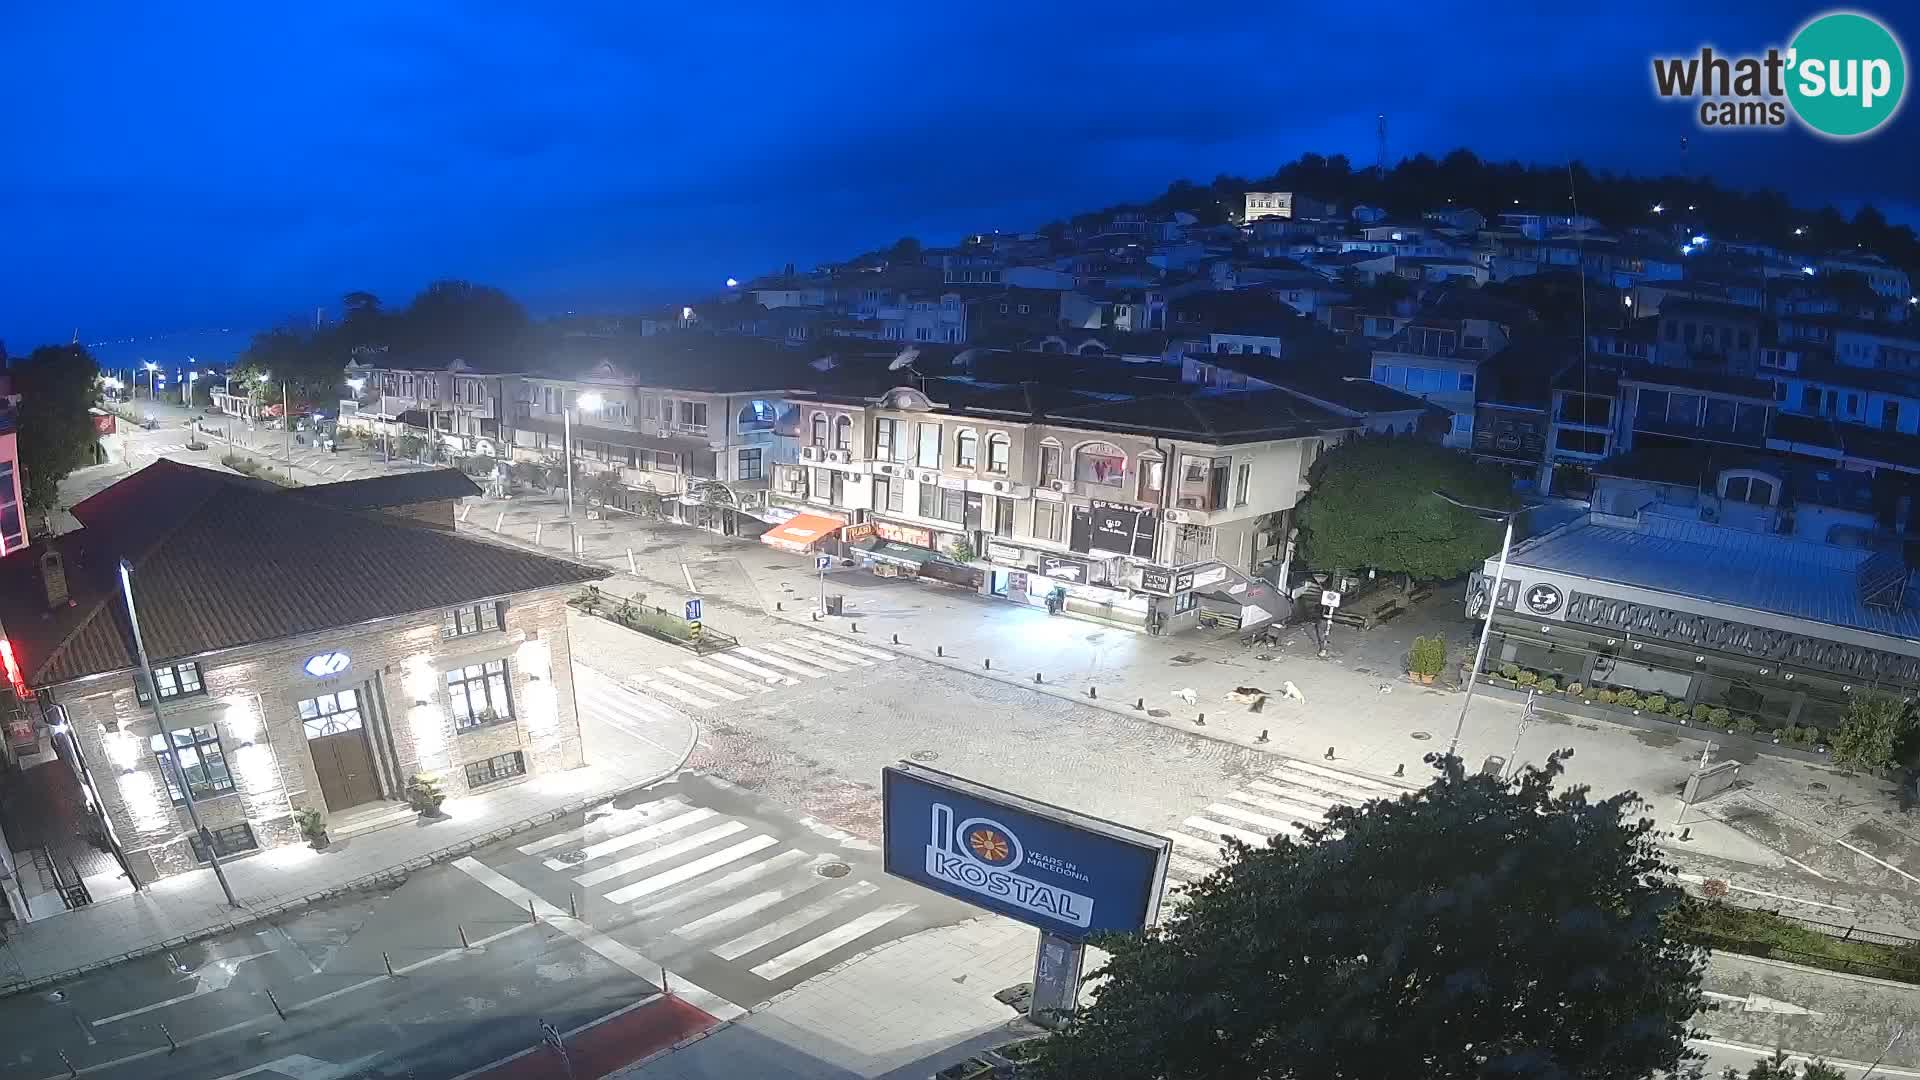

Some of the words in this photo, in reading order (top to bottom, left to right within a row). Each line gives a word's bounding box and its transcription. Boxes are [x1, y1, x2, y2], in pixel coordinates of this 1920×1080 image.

[819, 558, 828, 569] P
[1027, 849, 1064, 867] YEARS
[1065, 862, 1077, 871] IN
[1027, 857, 1090, 883] MACEDONIA
[936, 853, 1081, 922] KOSTAL
